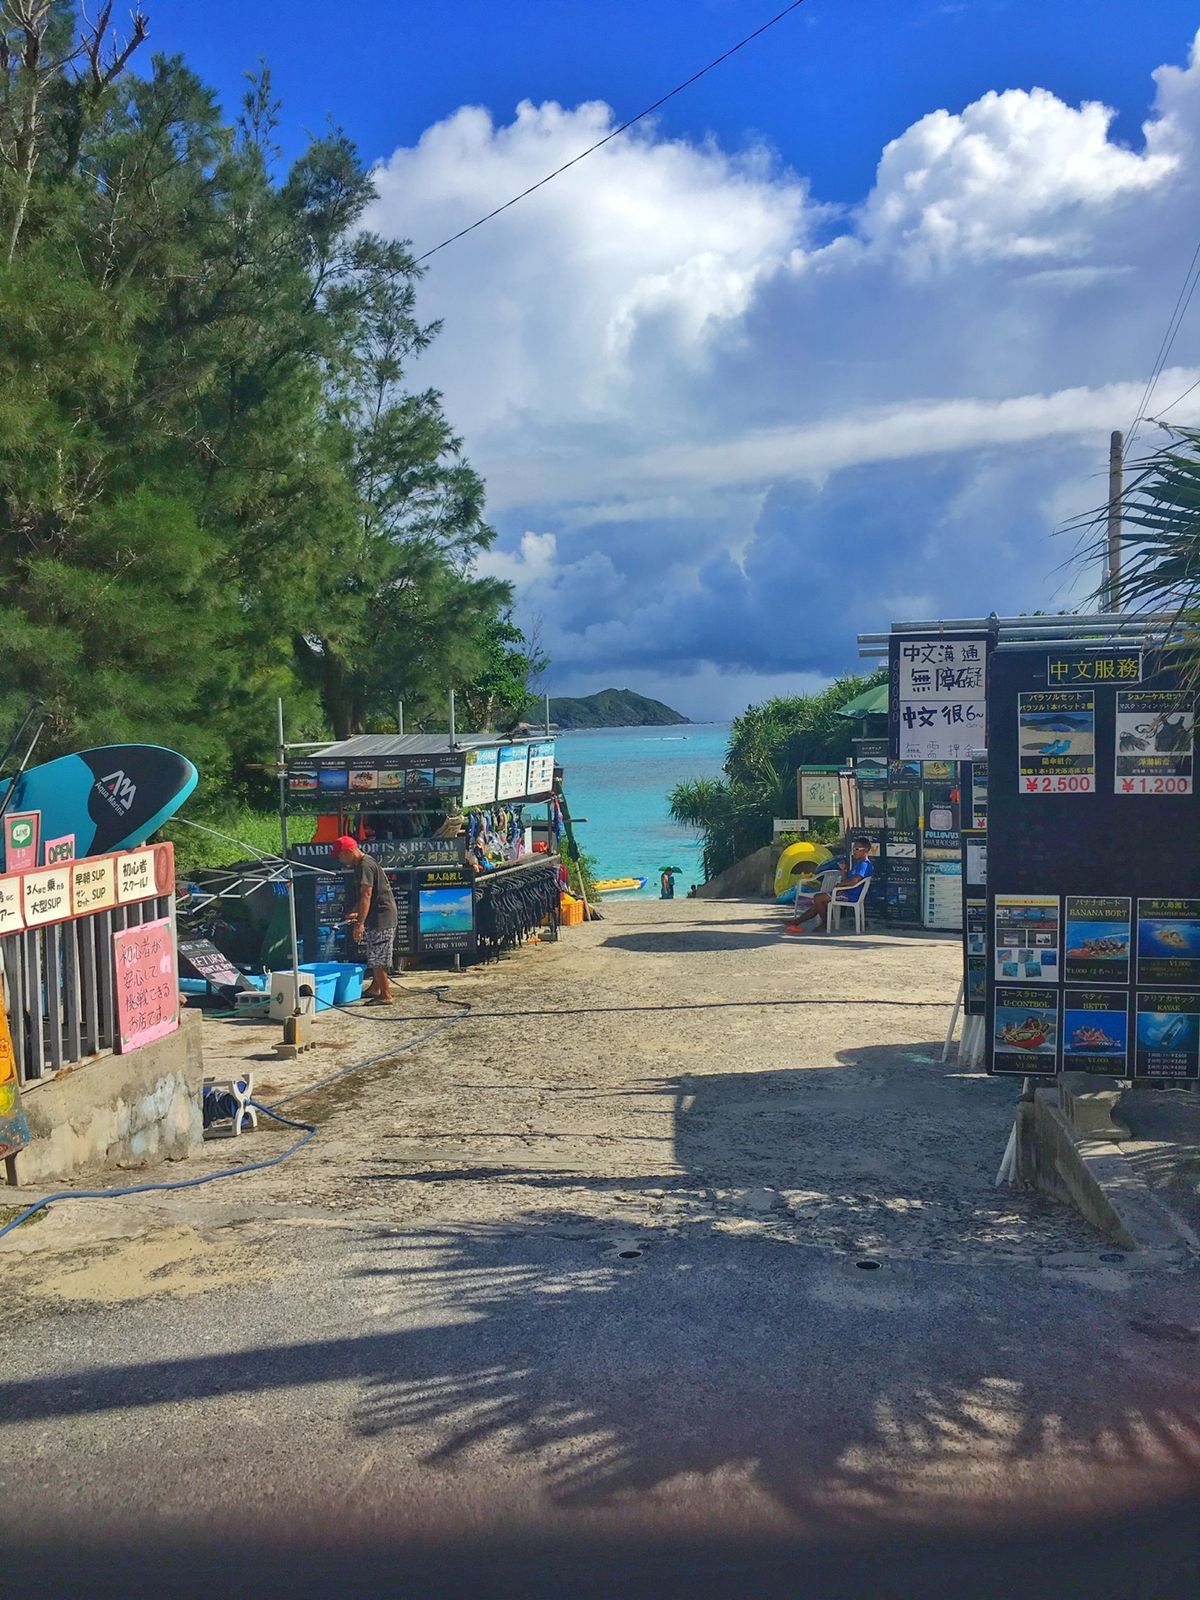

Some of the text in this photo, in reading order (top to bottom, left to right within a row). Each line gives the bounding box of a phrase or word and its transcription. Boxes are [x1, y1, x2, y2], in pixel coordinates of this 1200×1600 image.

[903, 643, 980, 664] 中文溝通
[911, 666, 983, 693] 無障礙
[1050, 657, 1139, 681] 中文服務
[95, 781, 125, 817] Aqua Marina
[48, 841, 73, 864] OPEN
[296, 841, 457, 857] MARIN PORTS & RENTAL
[91, 869, 105, 881] SUP
[122, 859, 147, 877] 初心者
[92, 887, 106, 900] SUP
[31, 897, 61, 915] 大型SUP
[120, 937, 162, 965] 初心者が
[189, 953, 227, 967] RETURN
[124, 965, 158, 989] 安心して
